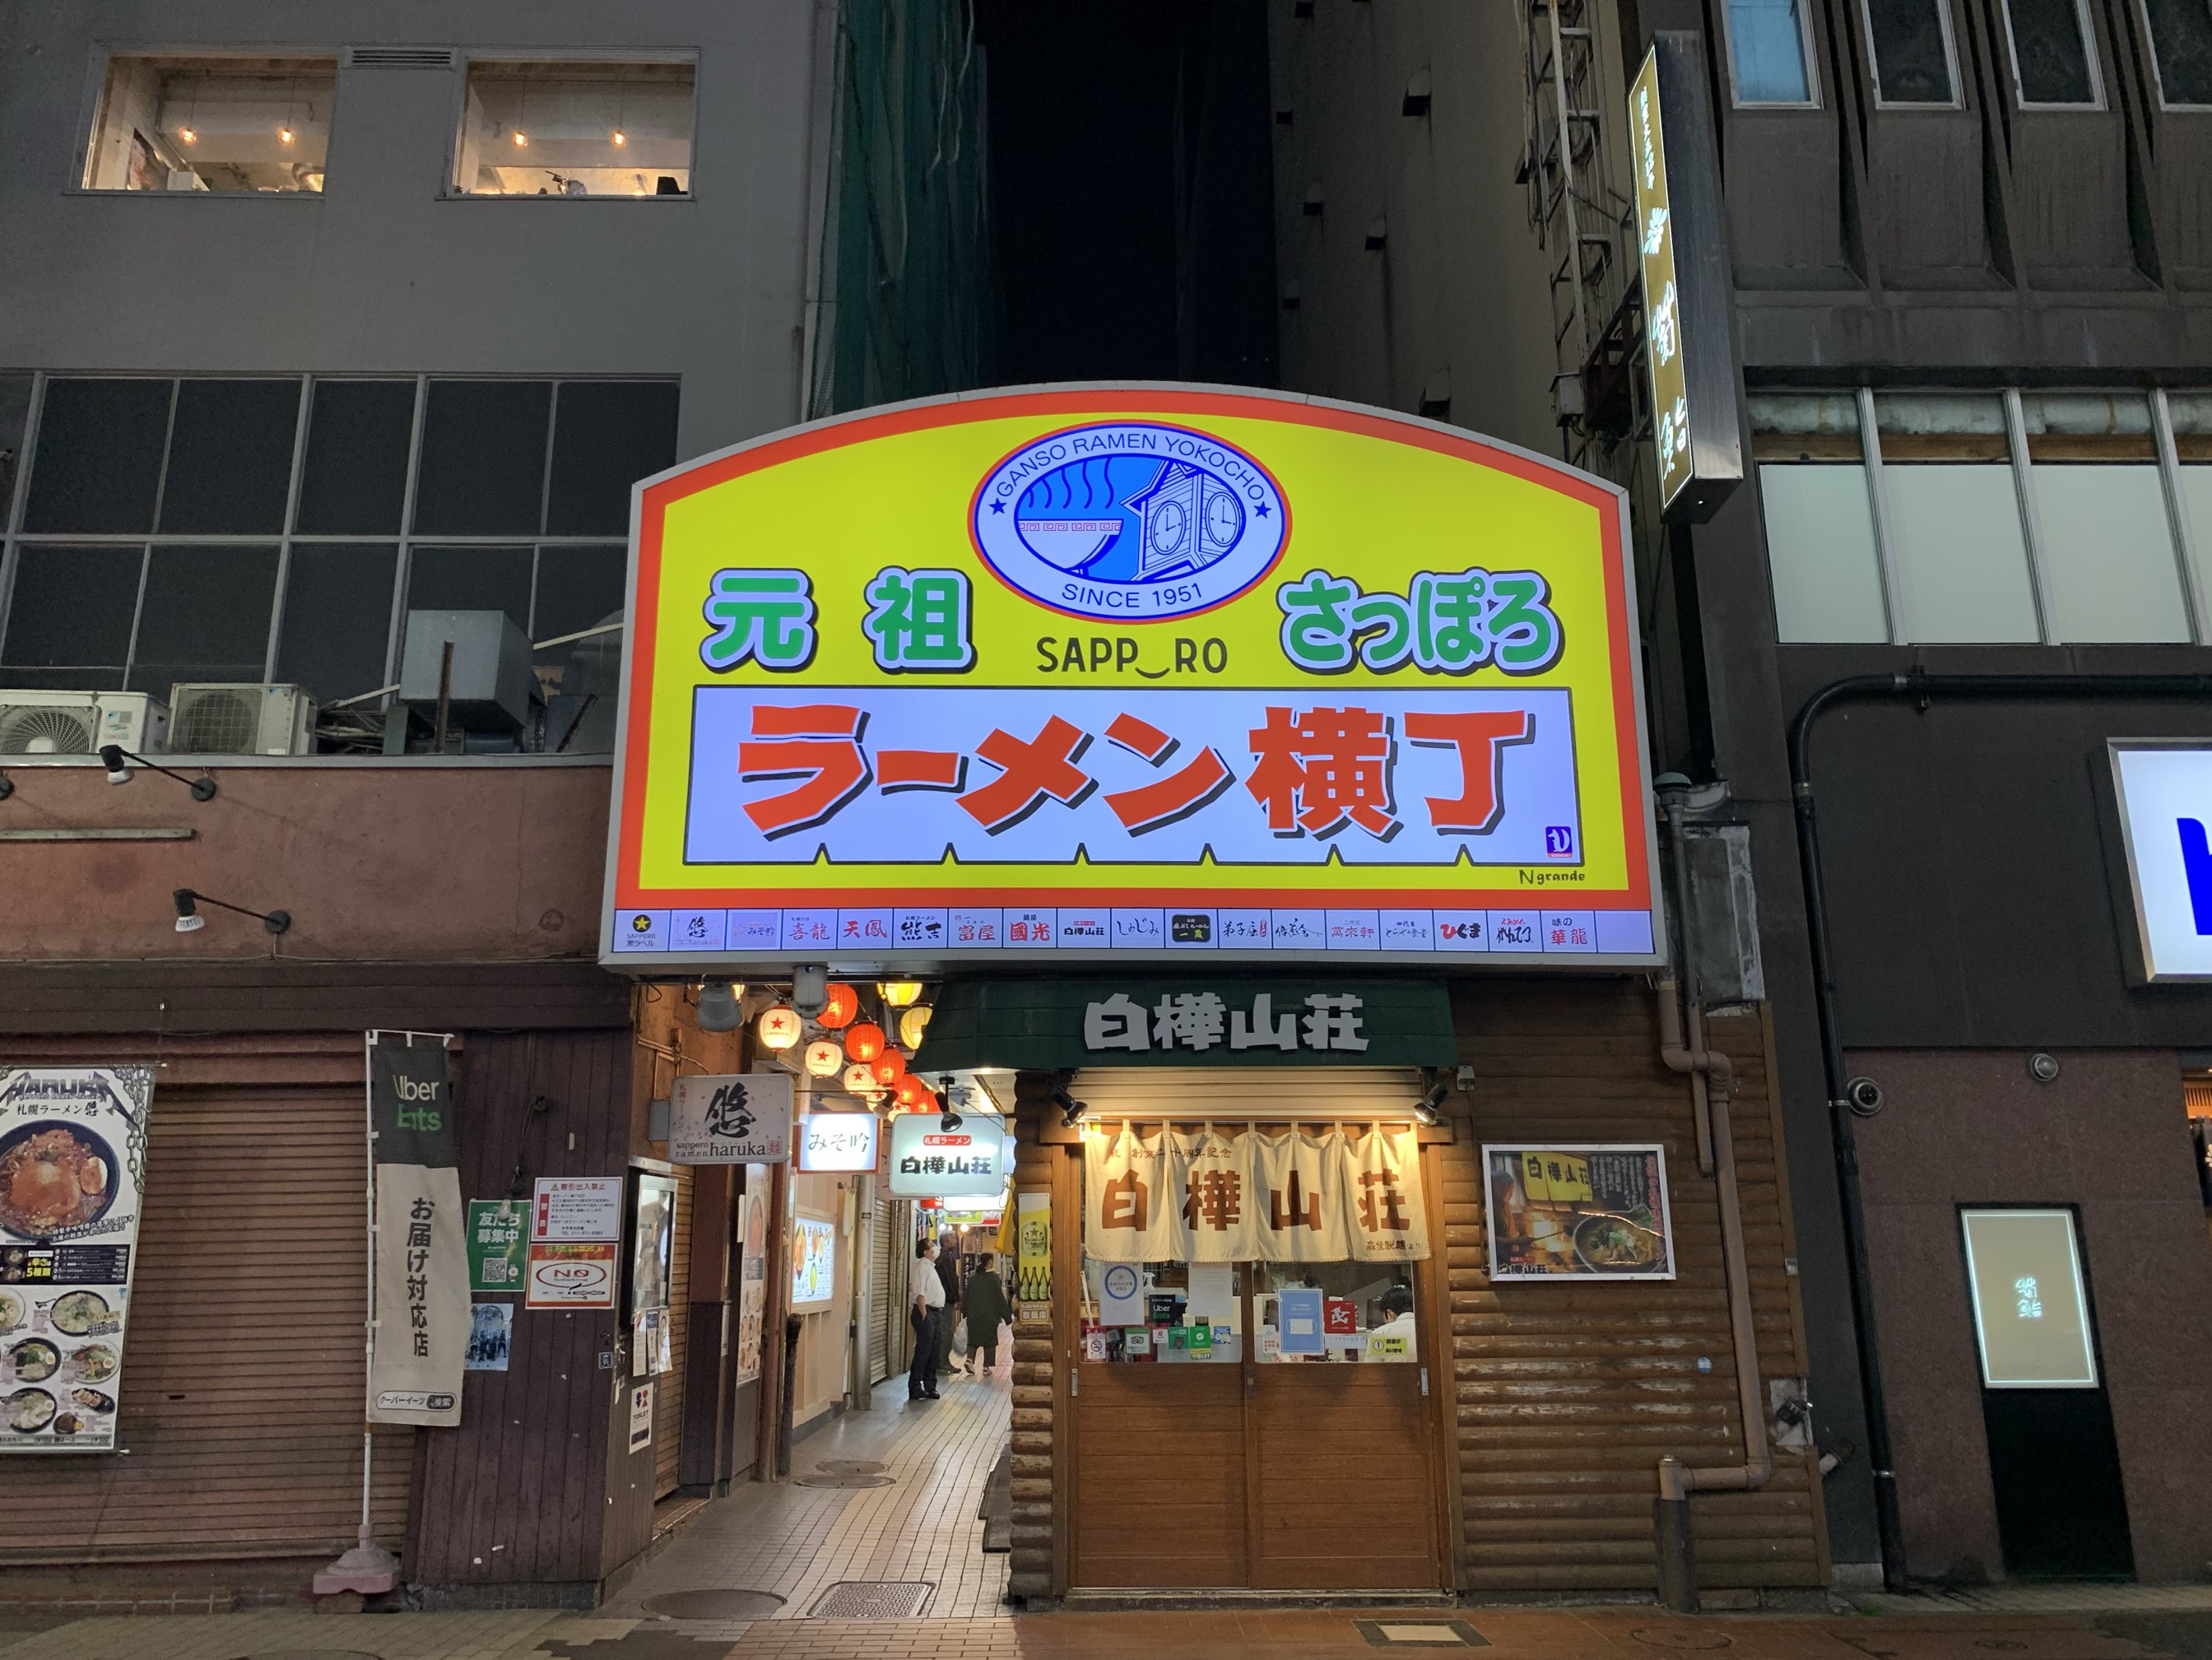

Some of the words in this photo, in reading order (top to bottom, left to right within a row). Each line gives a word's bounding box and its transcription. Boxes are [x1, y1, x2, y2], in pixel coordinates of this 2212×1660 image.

[996, 444, 1067, 497] GANSO
[1072, 433, 1157, 454] RAMEN
[1164, 435, 1265, 501] YOKOCHO
[1062, 583, 1141, 608] SINCE
[1152, 583, 1203, 607] 1951
[699, 565, 978, 675] 元祖
[1276, 566, 1565, 677] さっぽろ
[737, 704, 1536, 844] ラーメン横丁
[686, 916, 709, 938] 悠
[788, 922, 830, 941] 喜龍
[843, 919, 889, 939] 天鳳
[901, 920, 942, 941] 熊吉
[1010, 921, 1050, 942] 國光
[1064, 927, 1105, 936] 白樺山荘
[1440, 923, 1481, 940] ひぐま
[1552, 918, 1573, 927] 味の
[958, 924, 996, 942] 富屋
[1386, 928, 1428, 938] とらや食堂
[1551, 928, 1587, 945] 華龍
[1084, 992, 1370, 1051] 白樺山荘
[704, 1081, 757, 1138] 悠
[709, 1141, 766, 1156] haruka
[808, 1132, 871, 1153] みそ吟
[923, 1135, 971, 1146] 札幌ラーメン
[676, 1150, 709, 1158] ramen
[900, 1155, 992, 1174] 白樺山荘
[1527, 1155, 1590, 1186] 白樺山荘
[1101, 1168, 1410, 1233] 白樺山荘
[26, 1267, 51, 1277] 5種類
[407, 1197, 435, 1357] お届け対応店
[633, 1410, 649, 1421] TOILET
